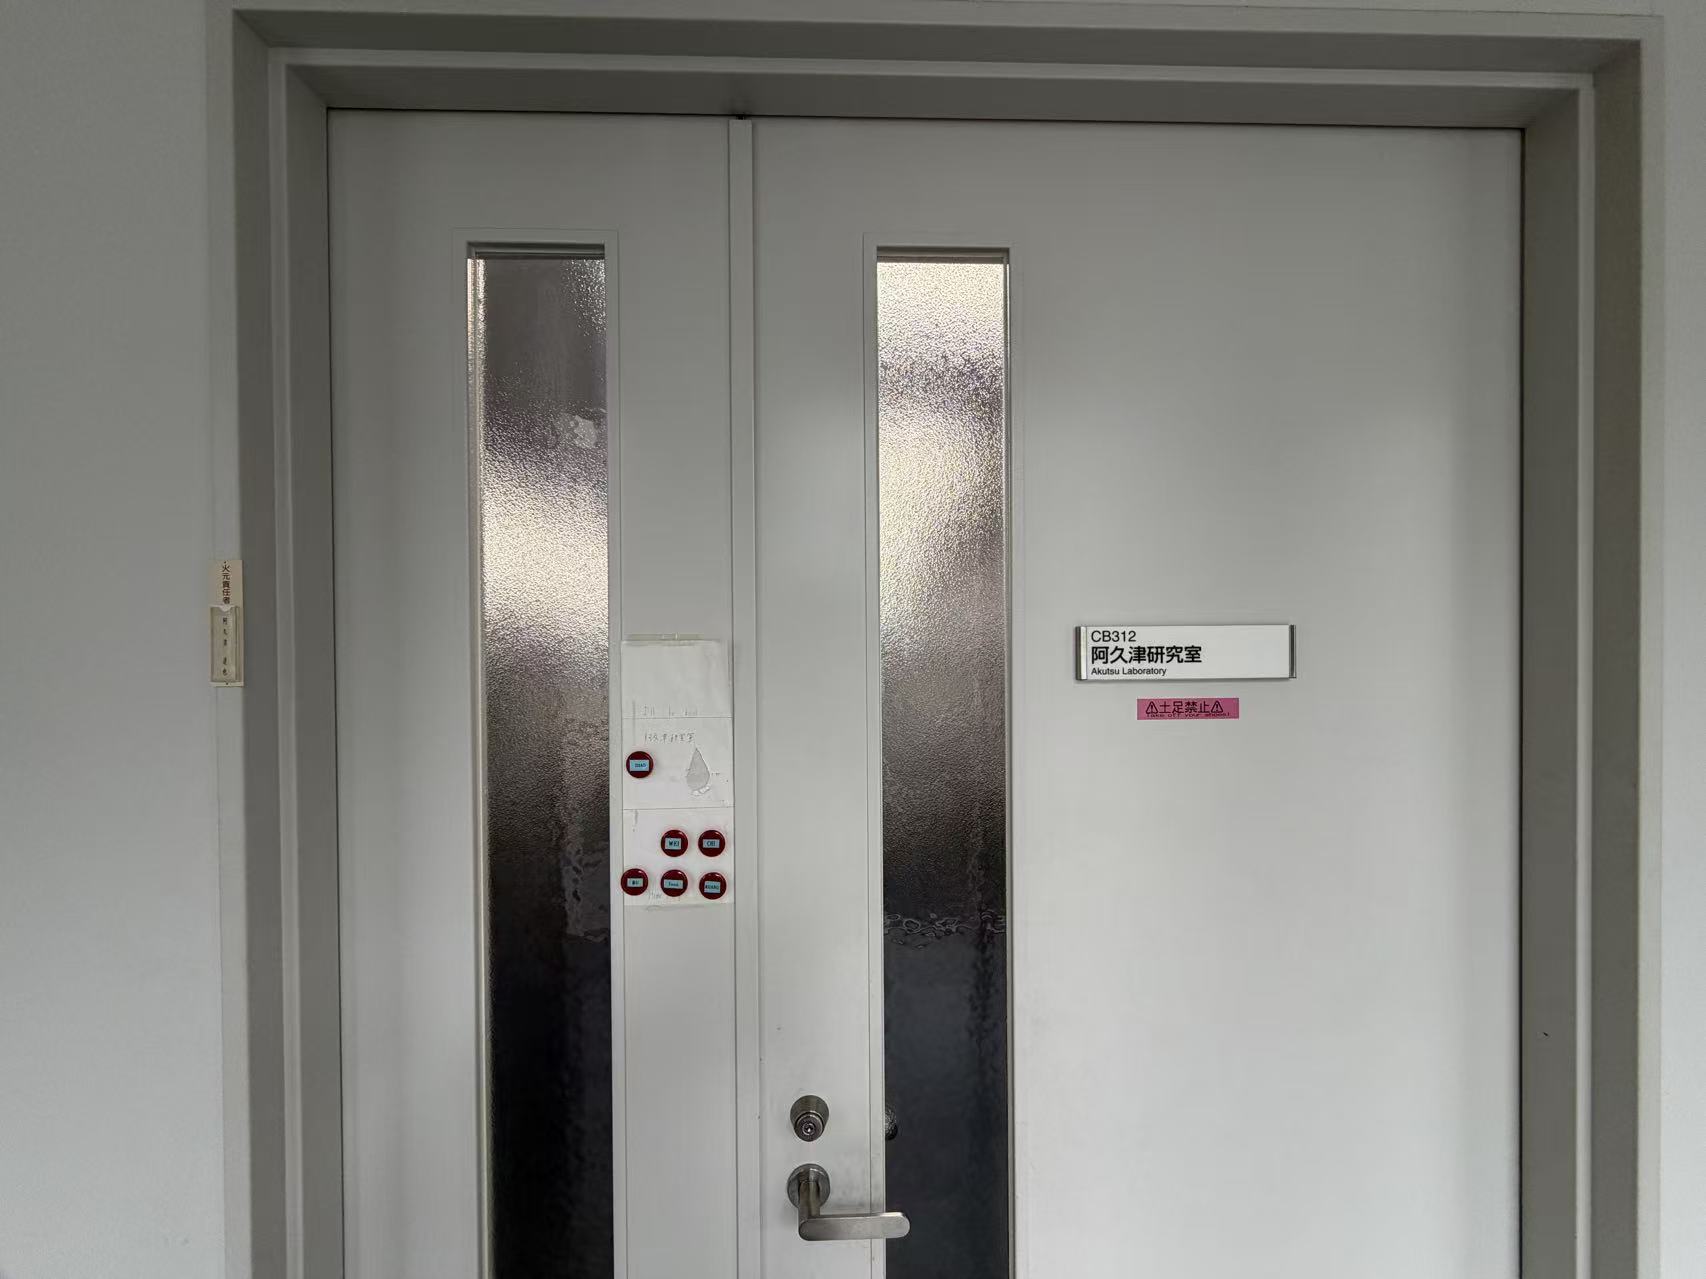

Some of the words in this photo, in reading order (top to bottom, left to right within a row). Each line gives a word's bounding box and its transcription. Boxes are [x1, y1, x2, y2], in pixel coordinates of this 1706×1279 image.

[1091, 630, 1137, 642] CB312
[1091, 645, 1202, 665] 阿久津研究室
[1091, 667, 1120, 676] Akutsu
[1122, 667, 1167, 677] Laboratory
[1159, 700, 1210, 714] 土足禁止
